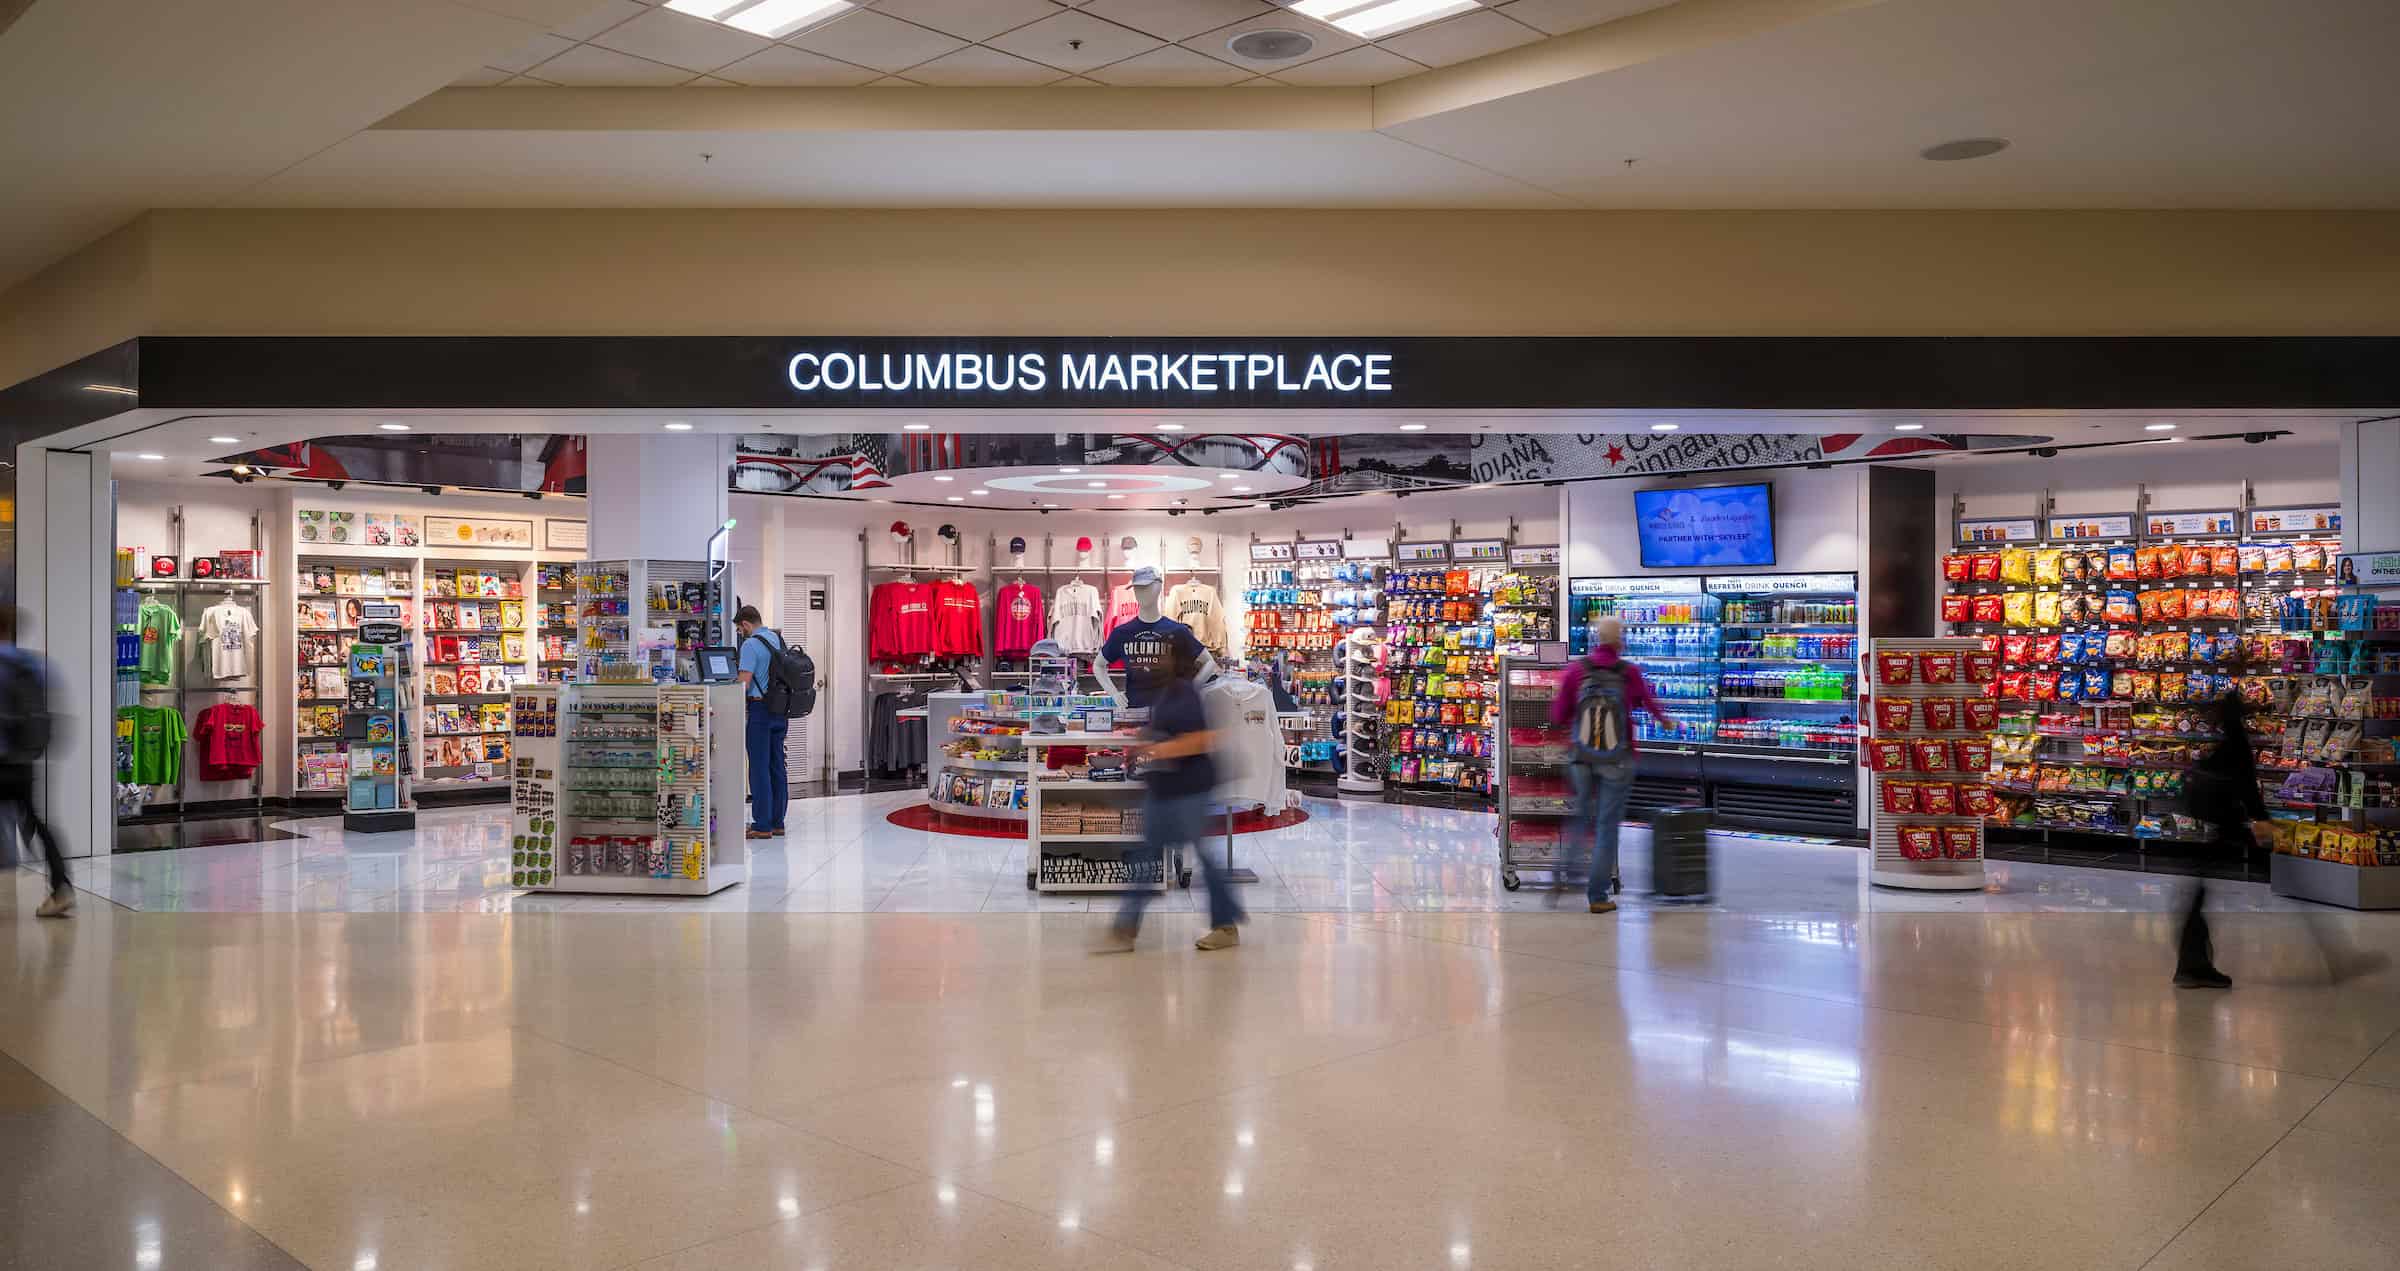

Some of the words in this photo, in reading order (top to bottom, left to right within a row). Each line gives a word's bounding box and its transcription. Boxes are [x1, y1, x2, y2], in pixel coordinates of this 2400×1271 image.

[787, 352, 1047, 392] COLUMBUS
[1061, 352, 1393, 392] MARKETPLACE
[1772, 581, 1808, 589] QUENCH
